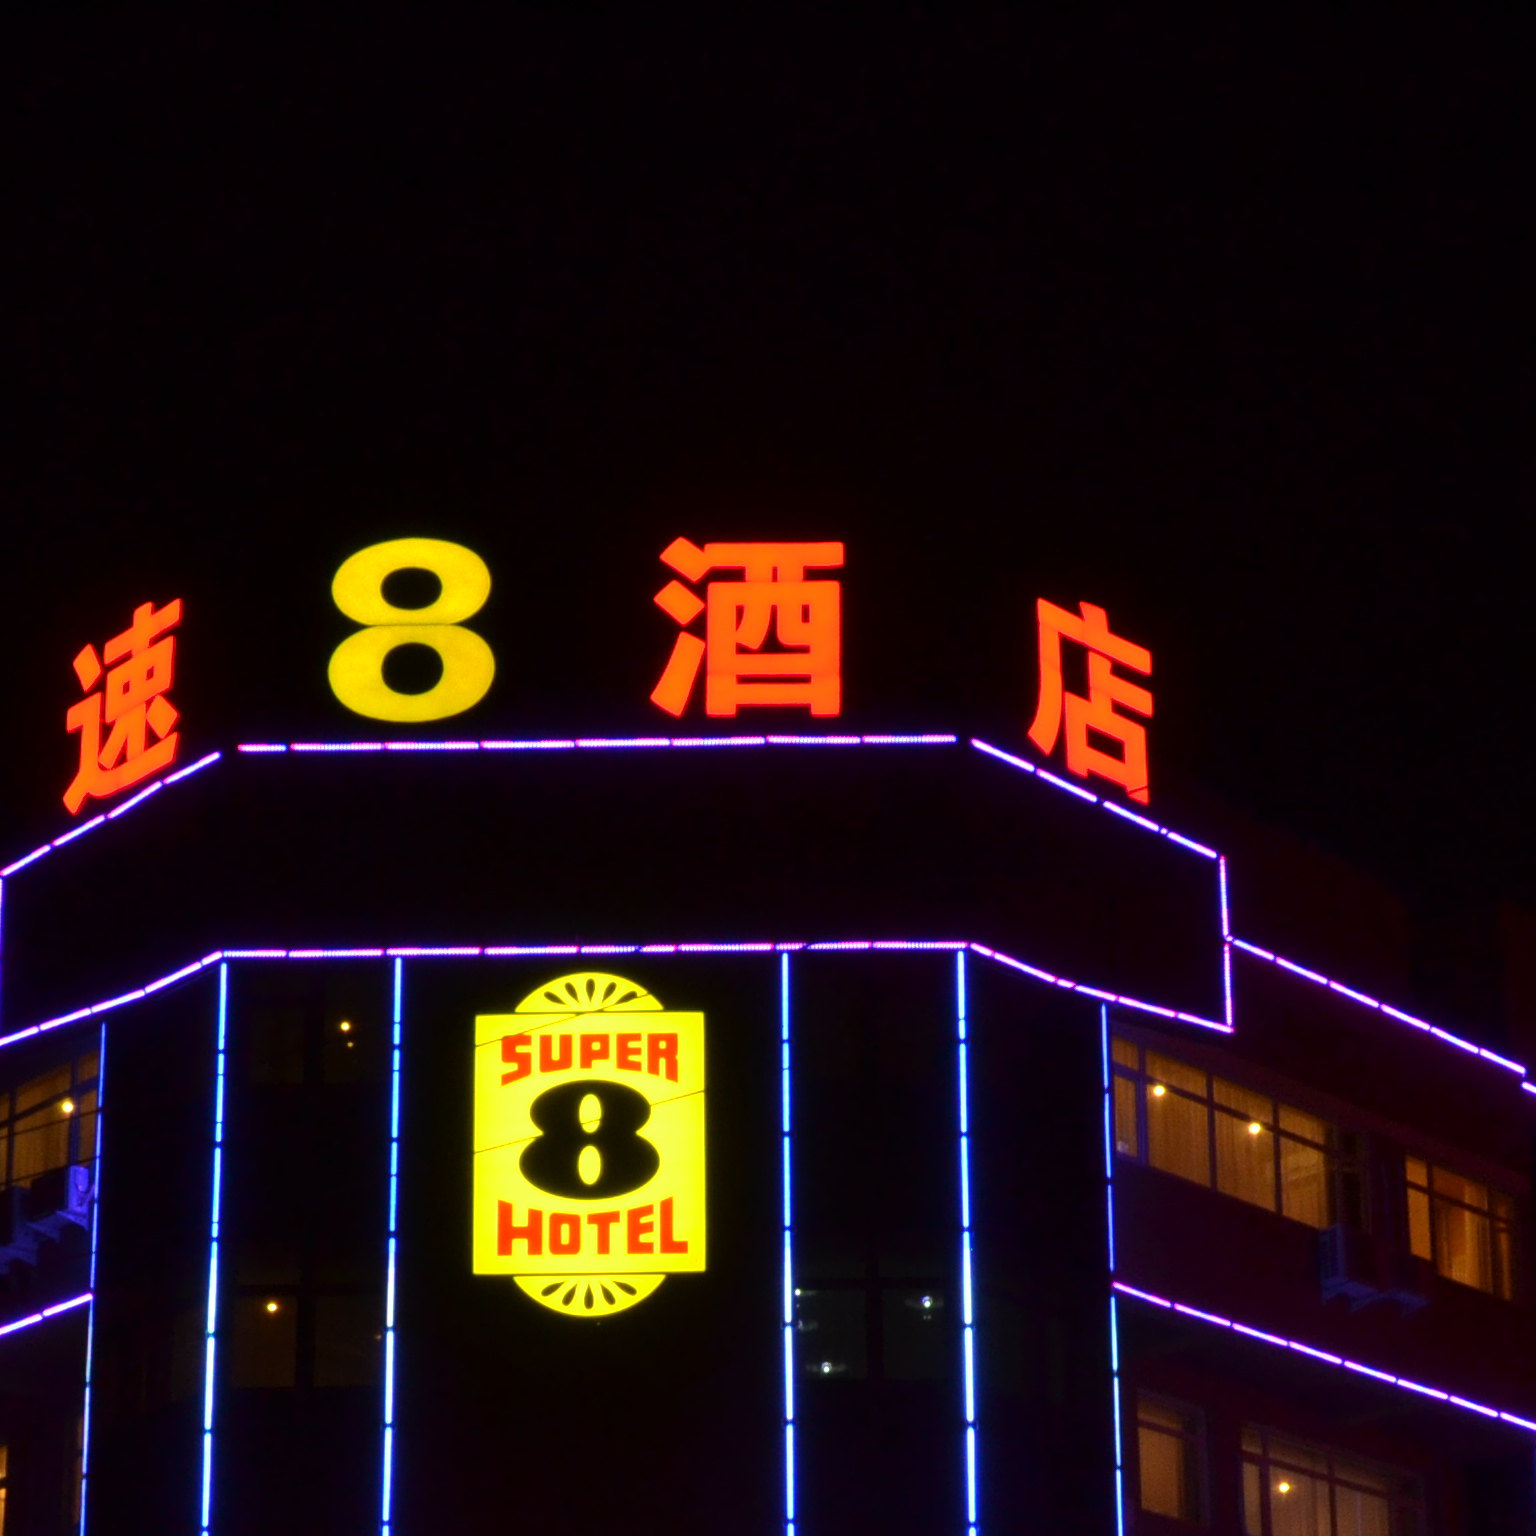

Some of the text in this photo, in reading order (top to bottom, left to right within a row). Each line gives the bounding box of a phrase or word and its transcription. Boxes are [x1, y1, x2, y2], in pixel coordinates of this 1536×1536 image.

[63, 536, 1153, 815] 速8酒店
[500, 1032, 679, 1086] SUPER
[519, 1079, 661, 1200] 8
[496, 1197, 689, 1257] HOTEL
